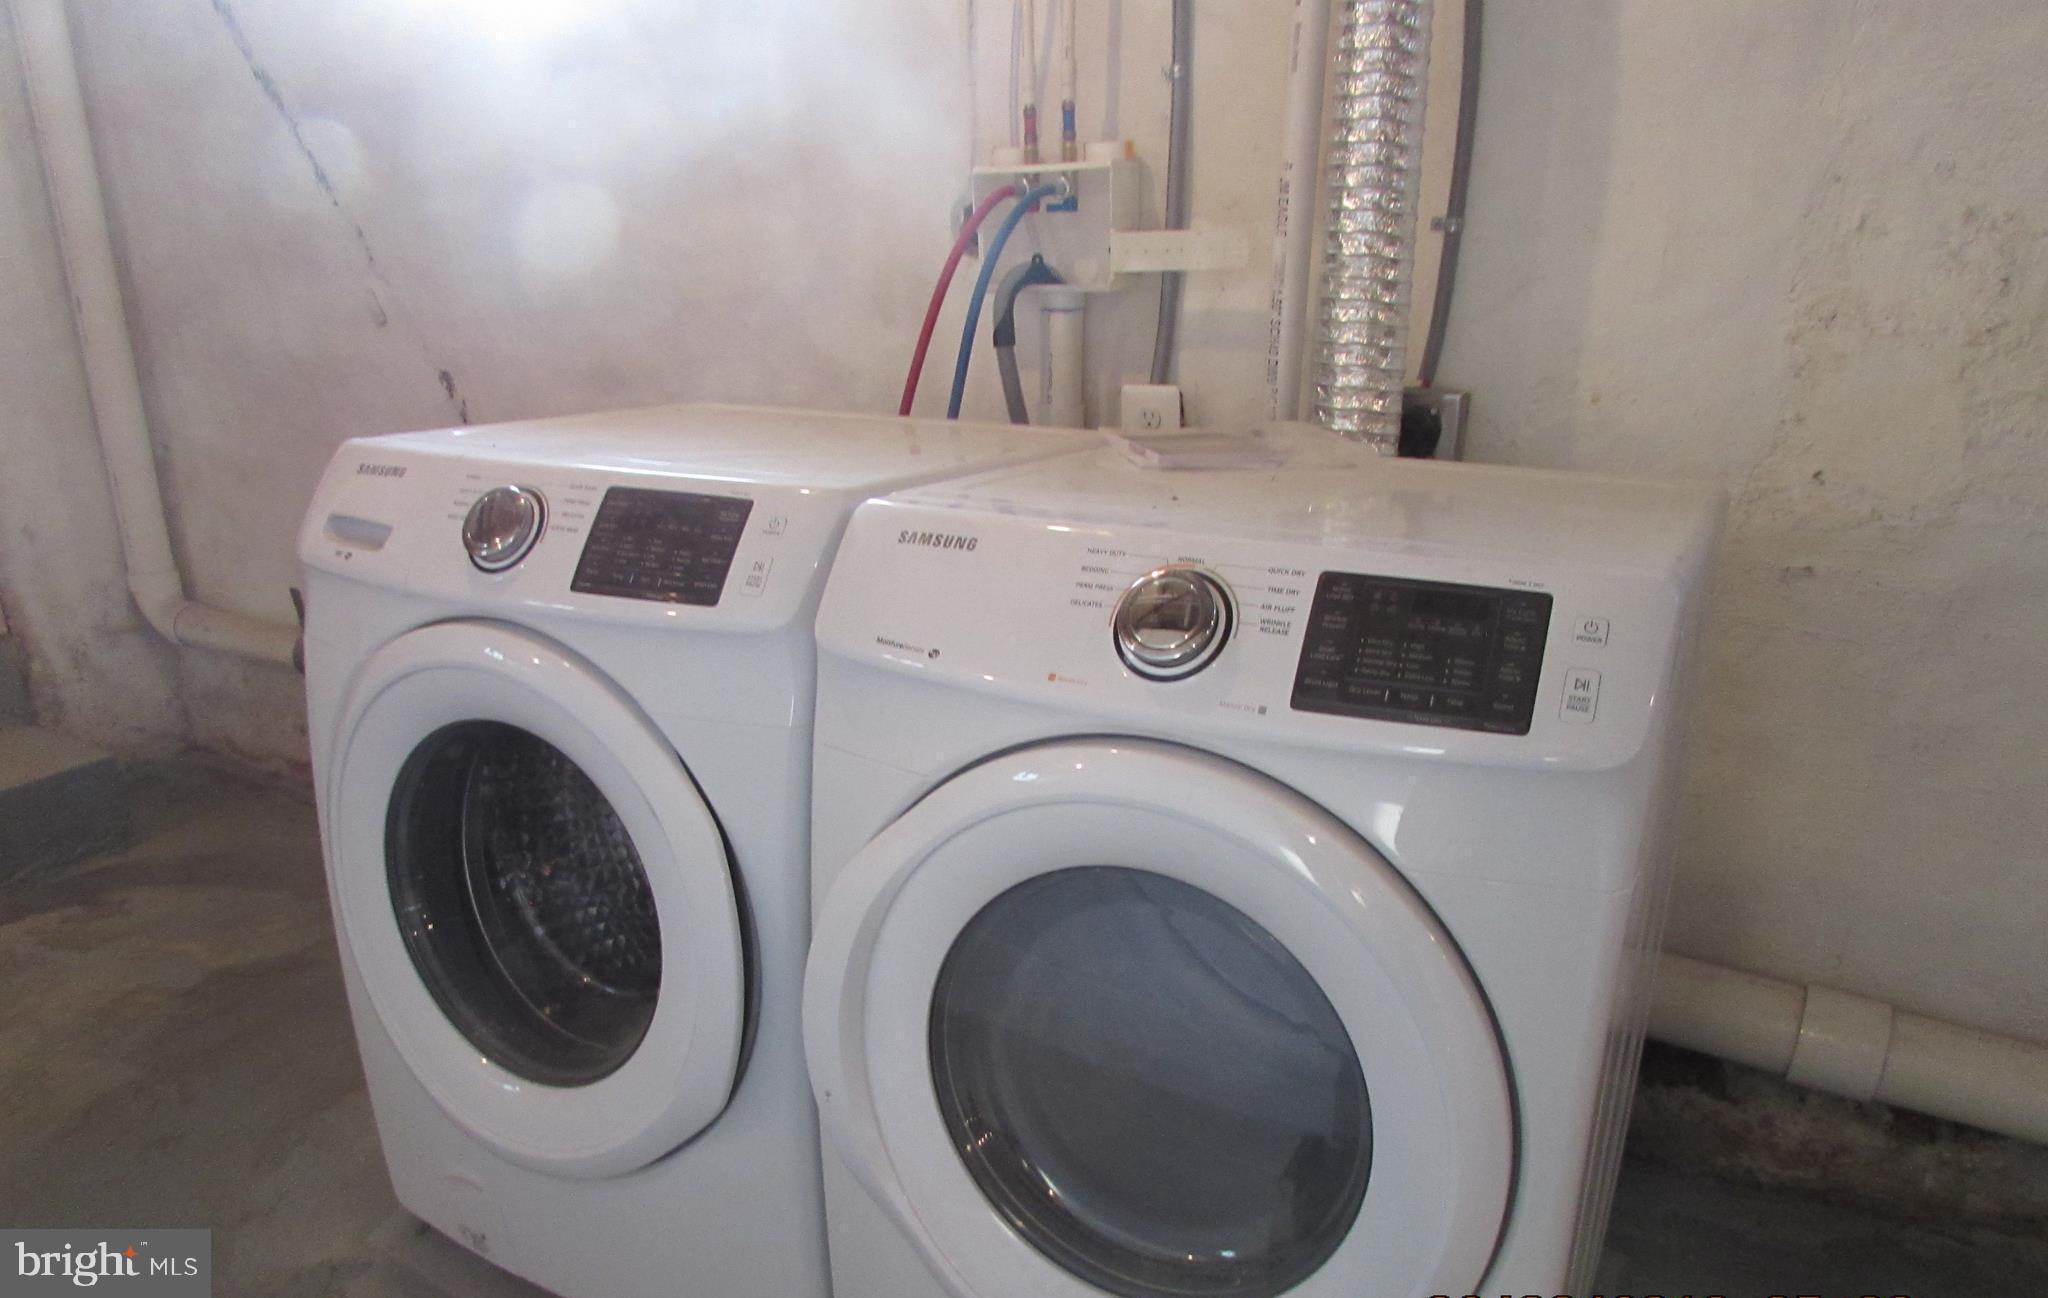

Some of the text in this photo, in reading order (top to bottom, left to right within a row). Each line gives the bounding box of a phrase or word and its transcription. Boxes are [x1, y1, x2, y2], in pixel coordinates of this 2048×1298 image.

[357, 463, 407, 478] SAMSUNG
[898, 530, 978, 552] SAMSUNG
[1087, 547, 1107, 556] HEAVY
[1177, 556, 1206, 565] NORMAL
[1267, 567, 1305, 577] QUICK DRY
[1267, 586, 1301, 597] TIME DRY
[1070, 599, 1103, 608] DELICATES
[1259, 603, 1296, 614] AIR FLUFF
[1259, 618, 1292, 628] WRINKLE
[1259, 627, 1289, 636] RELEASE
[1576, 635, 1602, 644] POWER
[1568, 695, 1591, 704] START
